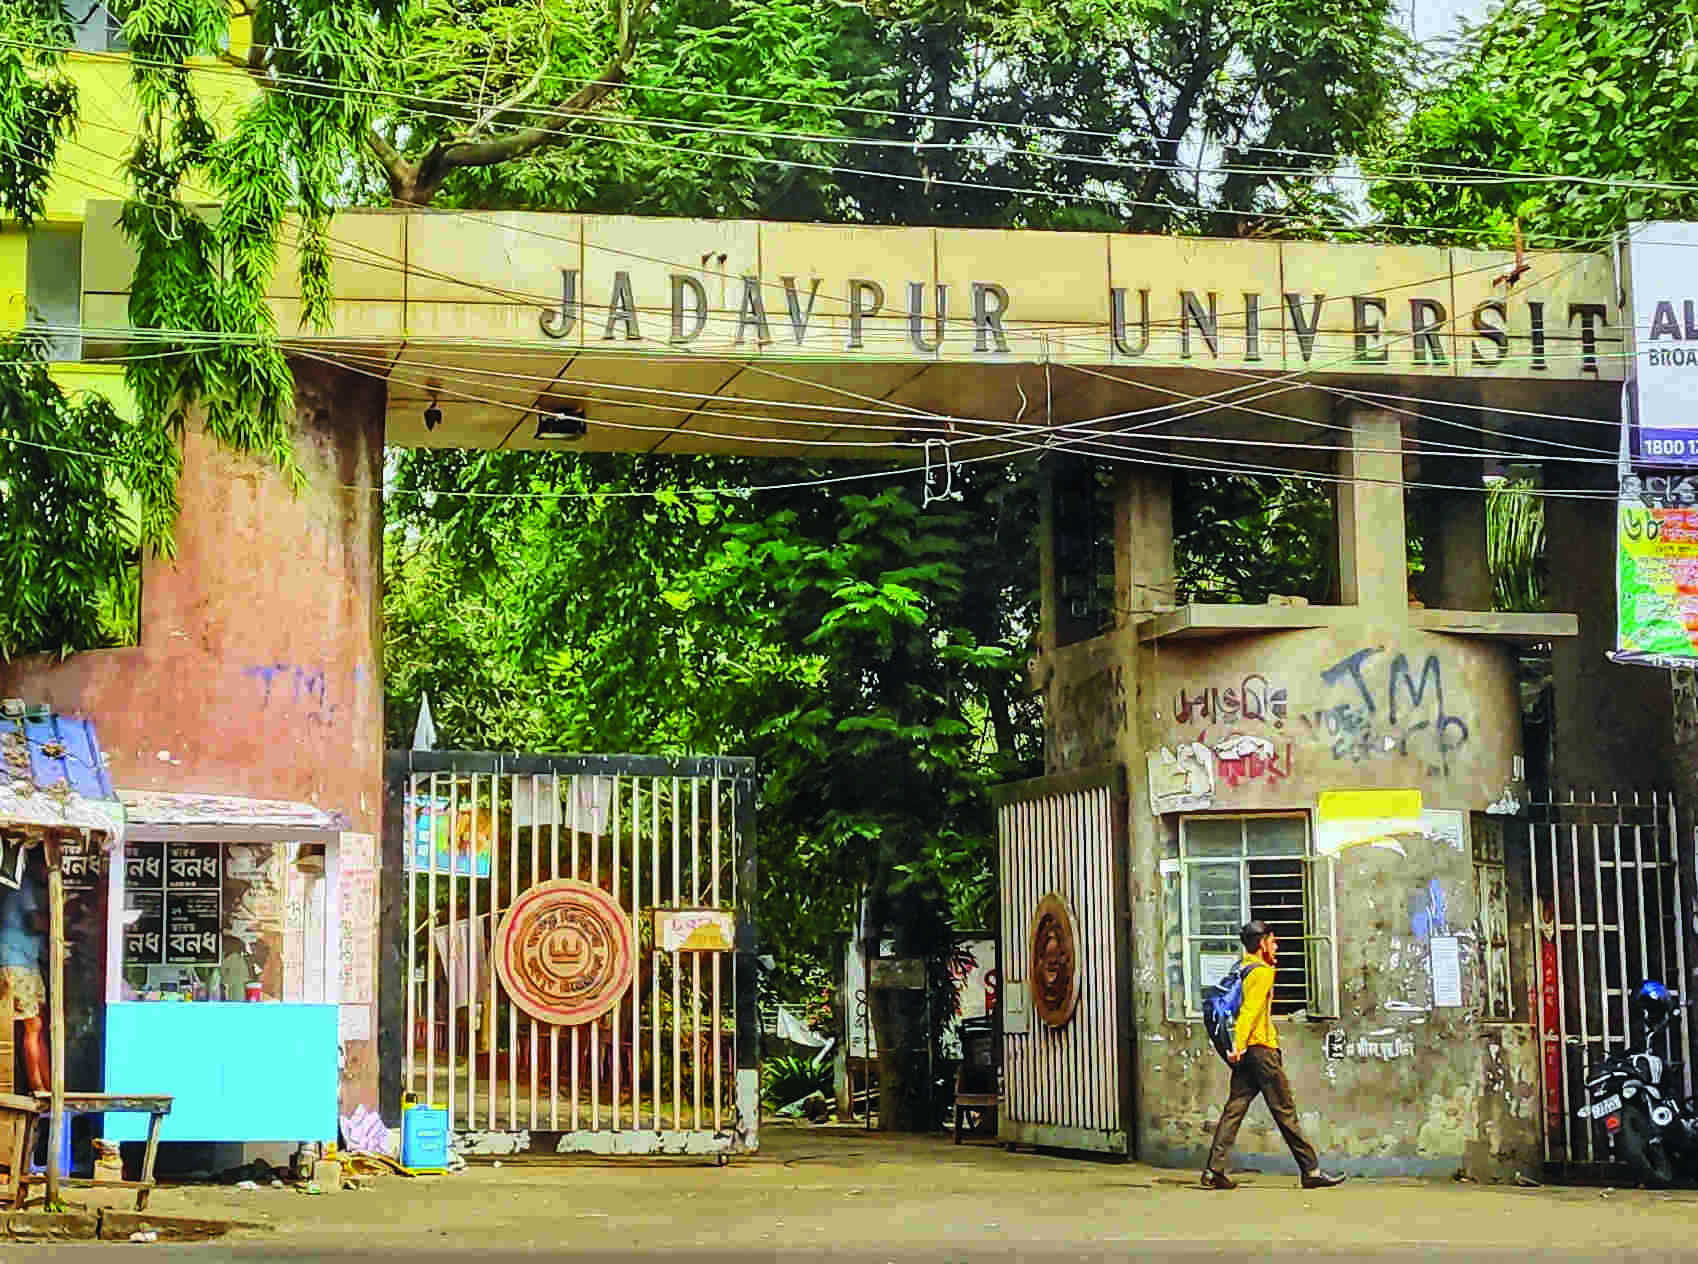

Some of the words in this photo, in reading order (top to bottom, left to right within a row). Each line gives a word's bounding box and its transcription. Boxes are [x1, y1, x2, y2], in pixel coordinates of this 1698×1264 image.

[539, 269, 1012, 353] JADAVPUR
[1109, 287, 1607, 374] UNIVERSIT
[1649, 348, 1698, 367] BROA
[1644, 439, 1685, 456] 1800
[127, 857, 161, 878] নধ
[169, 857, 217, 878] বনধ
[127, 932, 161, 953] নধ
[169, 932, 217, 953] বনধ
